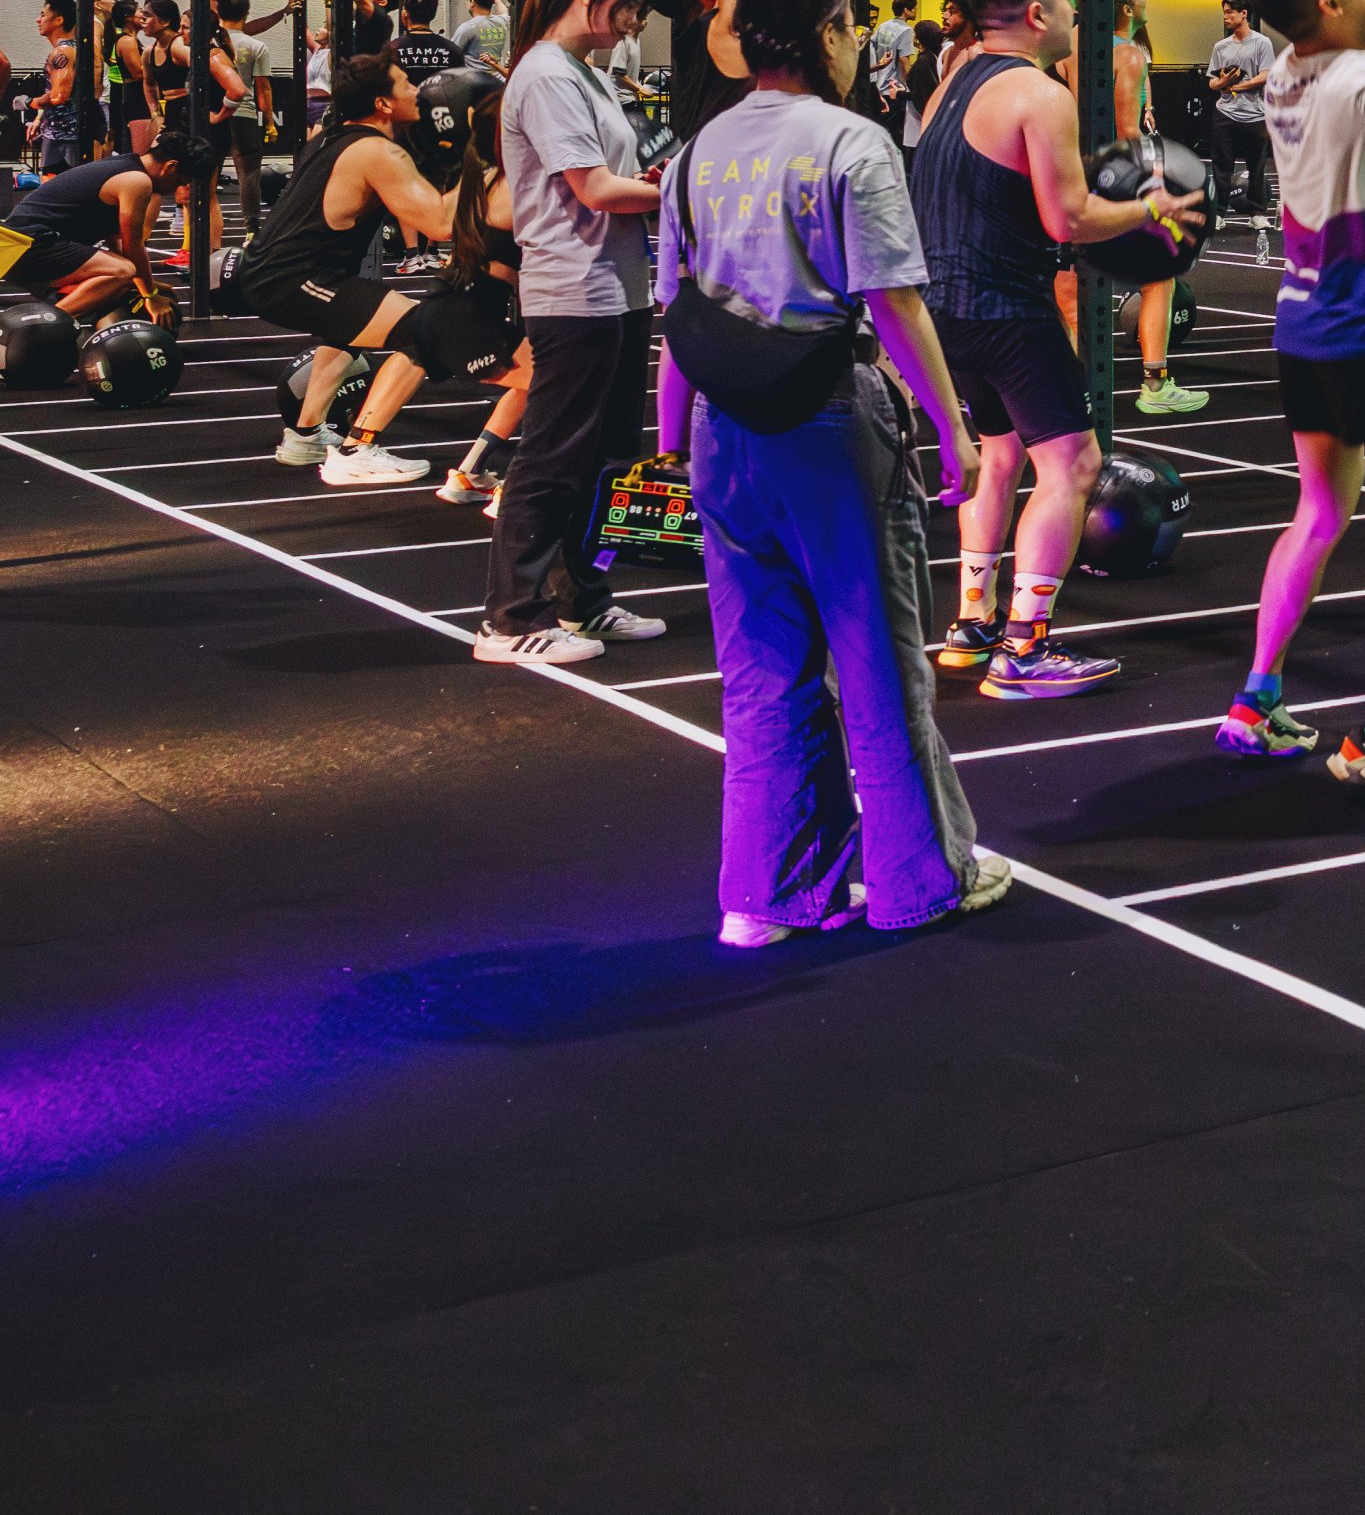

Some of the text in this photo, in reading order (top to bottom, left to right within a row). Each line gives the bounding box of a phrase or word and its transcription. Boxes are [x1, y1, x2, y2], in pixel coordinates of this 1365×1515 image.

[397, 46, 432, 56] TEAM
[697, 155, 772, 186] EAM
[689, 190, 819, 223] YROX
[223, 248, 241, 280] CENTR
[1173, 313, 1182, 325] 6
[91, 322, 142, 345] CENTR
[150, 357, 168, 369] KG
